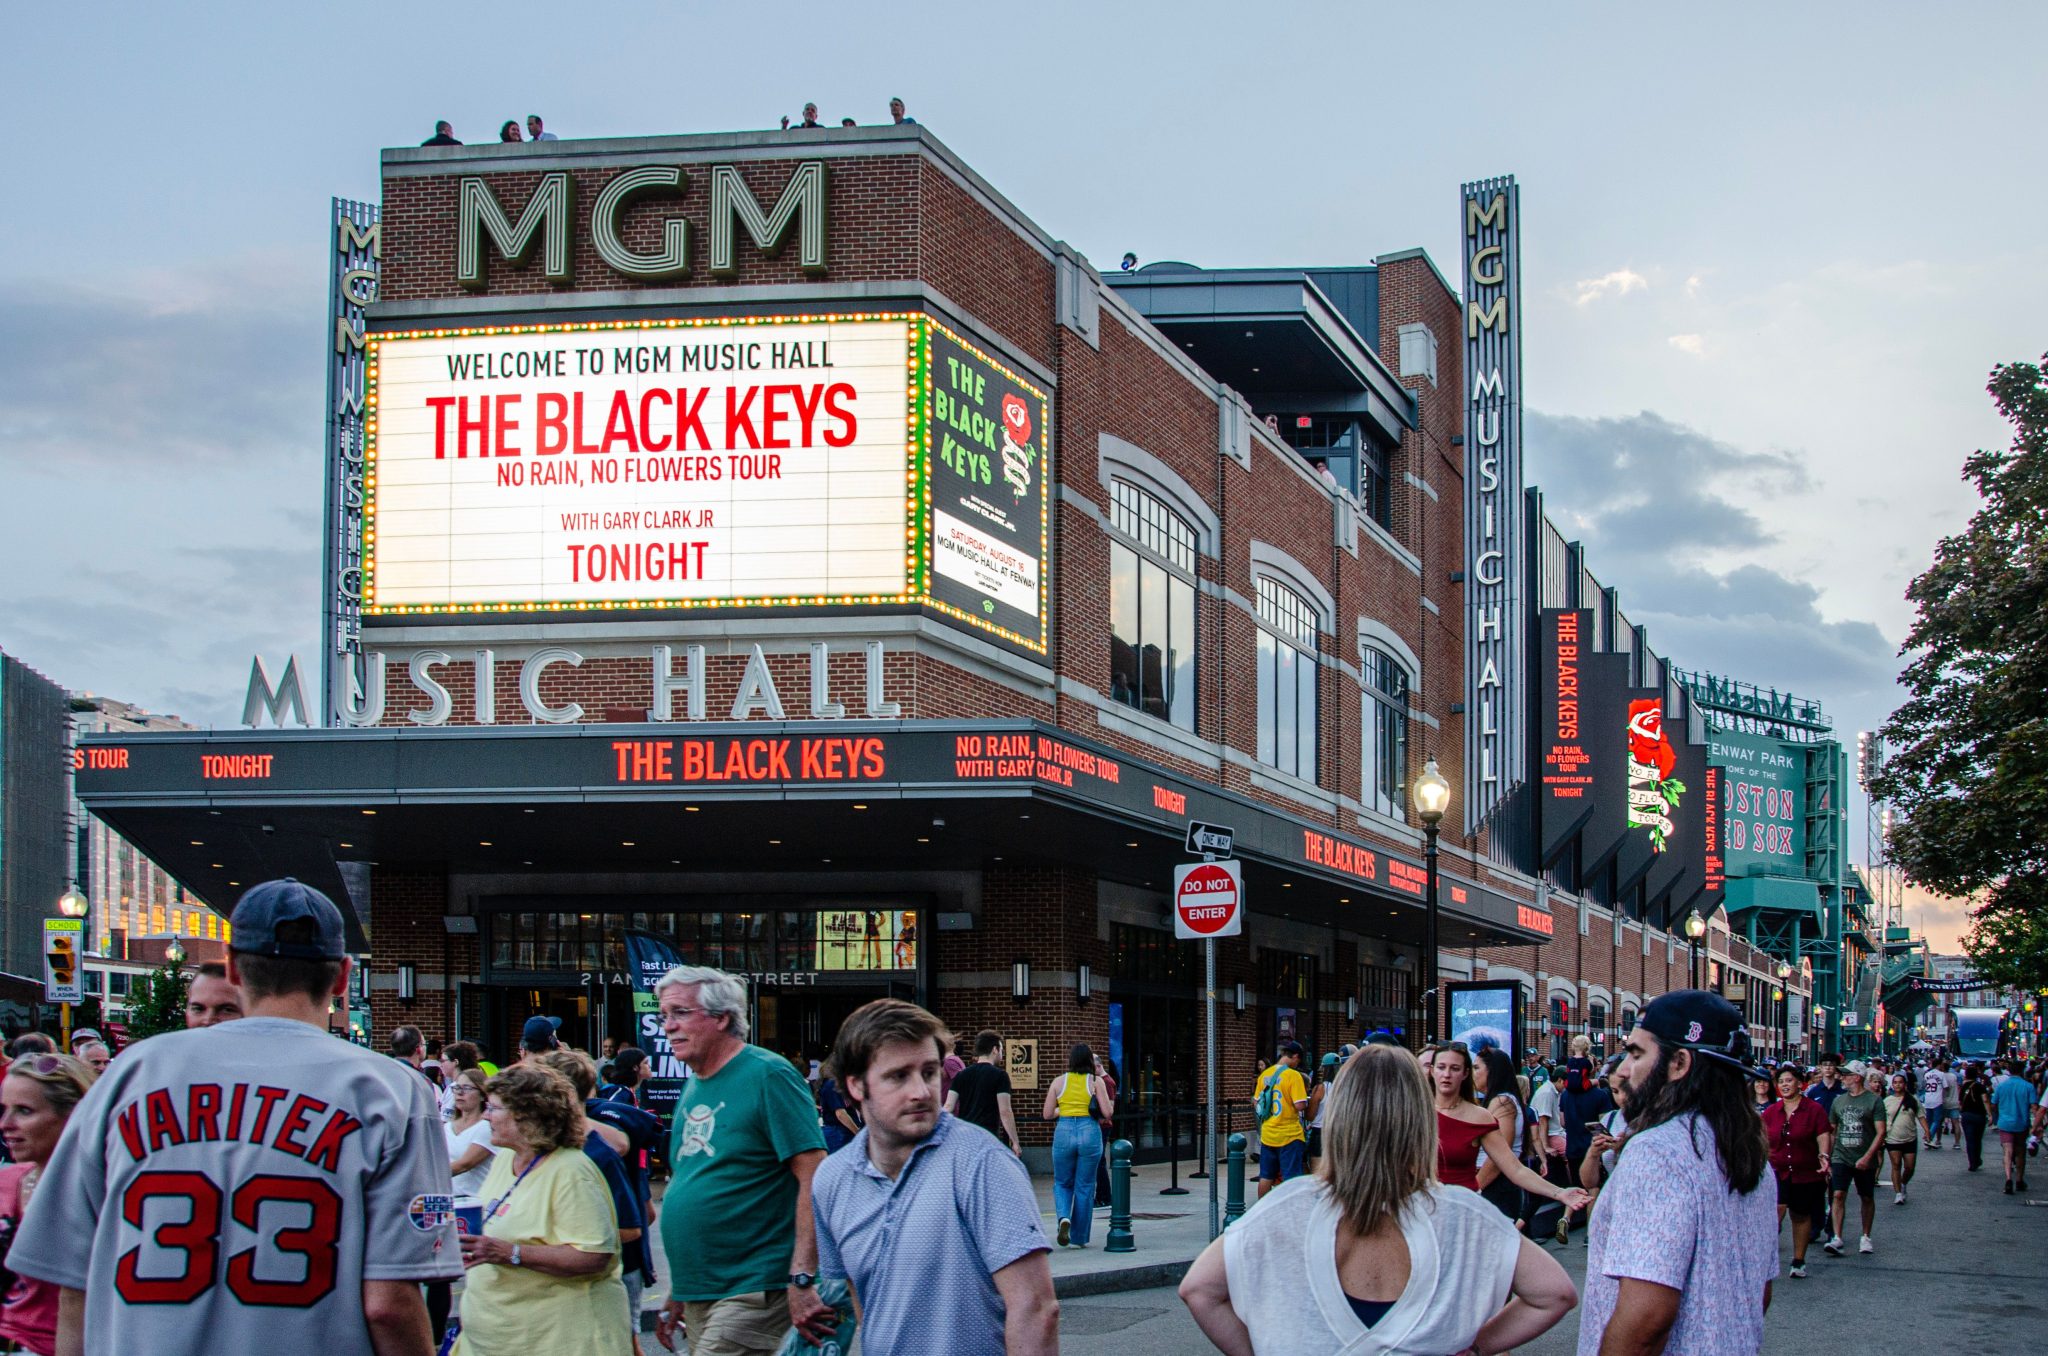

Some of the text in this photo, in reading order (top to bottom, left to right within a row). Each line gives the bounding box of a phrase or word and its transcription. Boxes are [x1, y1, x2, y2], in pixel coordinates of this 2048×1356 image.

[457, 160, 830, 289] MGM
[1467, 193, 1507, 338] MGM
[447, 341, 834, 381] WELCOME TO MGM MUSIC HALL
[947, 356, 986, 406] THE
[426, 382, 857, 459] THE BLACK KEYS
[935, 387, 996, 451] BLACK
[497, 454, 781, 489] NO RAIN, NO FLOWERS TOUR
[940, 432, 992, 485] KEYS
[1472, 367, 1505, 585] MUSIC
[561, 510, 714, 531] WITH GARY CLARK JR
[959, 496, 980, 514] GARY
[981, 507, 1005, 527] CLARK
[567, 542, 709, 583] TONIGHT
[937, 535, 1035, 590] MGM MUSIC HALL AT FENWAY
[950, 528, 1025, 573] SATURDAY, AUGUST 16
[242, 640, 902, 727] MUSIC HALL
[1478, 607, 1502, 782] HALL
[1557, 612, 1578, 739] THE BLACK KEYS
[88, 748, 129, 768] TOUR
[201, 754, 274, 778] TONIGHT
[613, 738, 885, 782] THE BLACK KEYS
[956, 735, 1119, 784] NO RAIN, NO FLOWERS TOUR
[1546, 755, 1590, 763] NO FLOWERS
[1552, 745, 1583, 756] NO RAIN,
[1559, 764, 1577, 772] TOUR
[1712, 743, 1794, 769] ENWAY PARK
[956, 760, 1073, 787] WITH GARY CLARK JR
[1553, 788, 1583, 797] TONIGHT
[1749, 769, 1759, 777] OF
[1763, 771, 1777, 780] THE
[1153, 785, 1186, 815] TONIGHT
[1724, 780, 1793, 820] OSTON
[1202, 833, 1229, 847] ONE WAY
[1304, 830, 1323, 864] THE
[1324, 837, 1352, 874] BLACK
[1354, 847, 1376, 880] KEYS
[1724, 819, 1793, 855] ED SOX
[1185, 878, 1230, 892] DO NOT
[48, 921, 79, 929] SCHOOL
[1189, 907, 1226, 920] ENTER
[641, 961, 660, 970] Fast
[739, 972, 818, 985] STREET
[118, 1083, 363, 1173] VARITEK
[115, 1171, 343, 1308] 33
